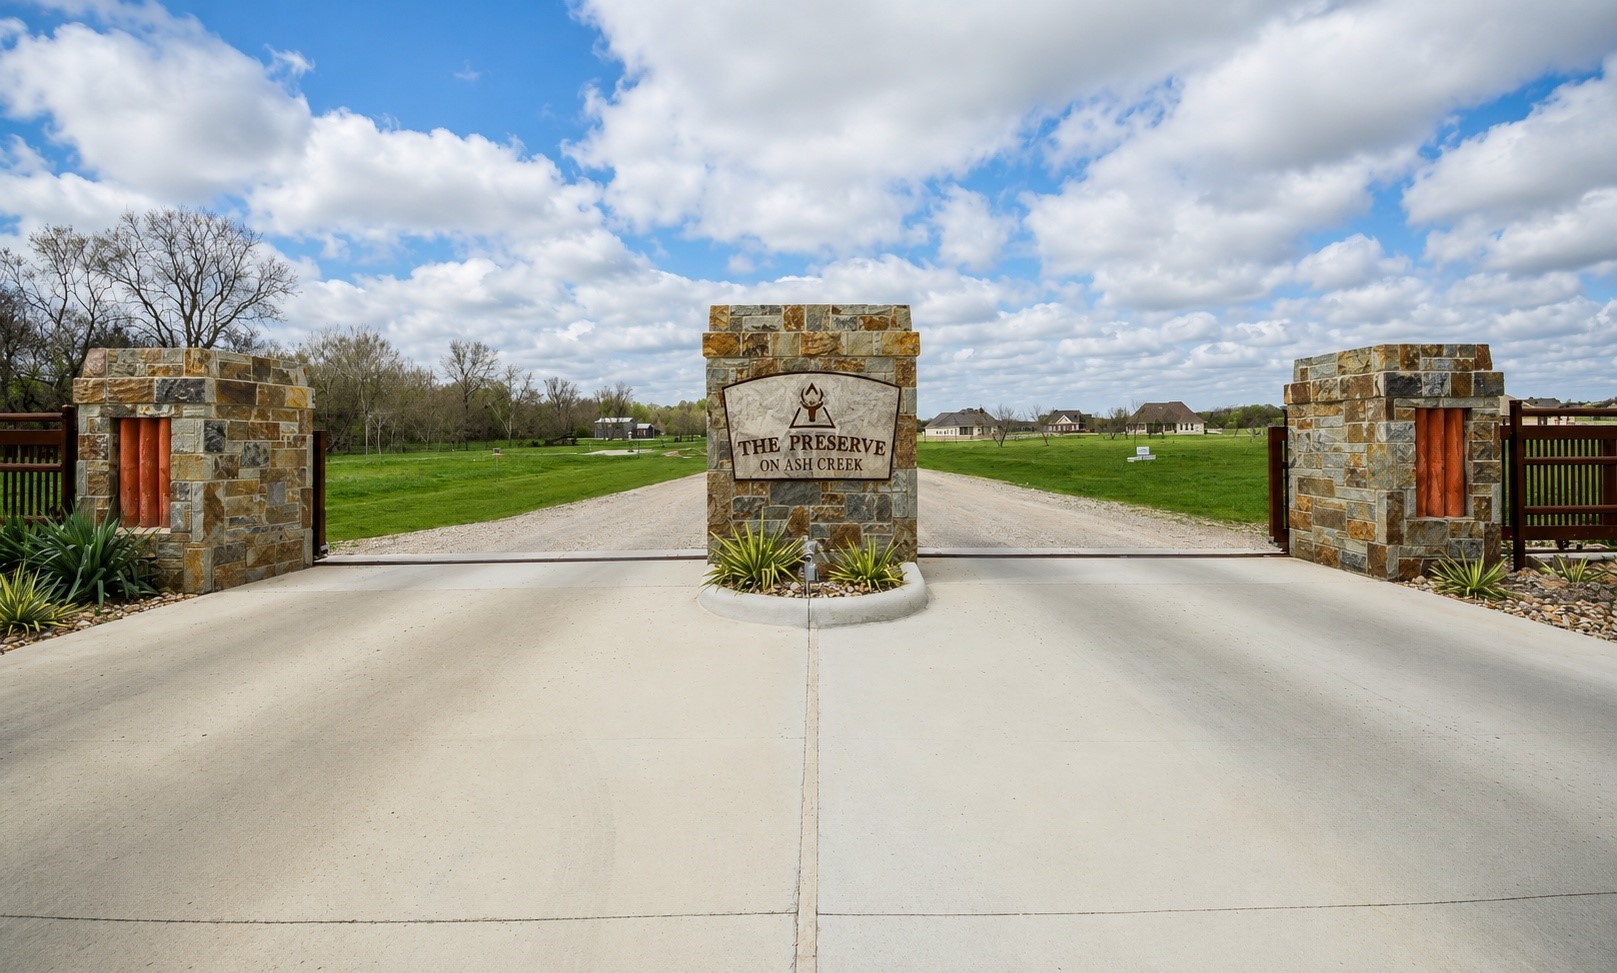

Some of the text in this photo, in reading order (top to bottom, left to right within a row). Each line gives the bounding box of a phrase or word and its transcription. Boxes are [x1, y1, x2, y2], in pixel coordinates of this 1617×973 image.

[737, 434, 886, 456] THE PRESERVE
[760, 457, 863, 472] ON ASH CREEK
